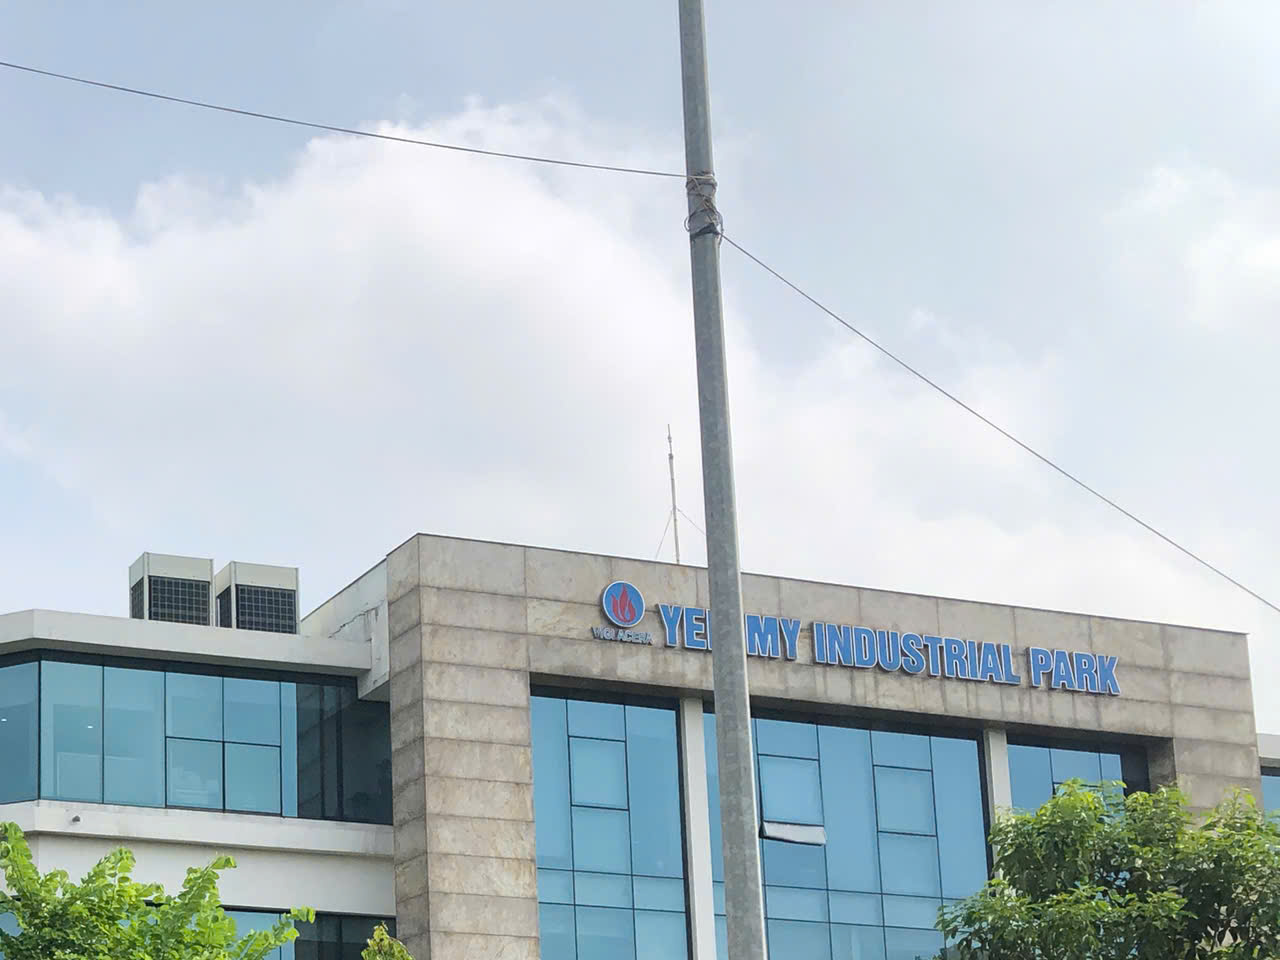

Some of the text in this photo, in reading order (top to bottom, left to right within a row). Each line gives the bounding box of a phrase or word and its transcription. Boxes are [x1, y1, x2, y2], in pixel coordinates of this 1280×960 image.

[658, 602, 1121, 695] YE MY INDUSTRIAL PARK
